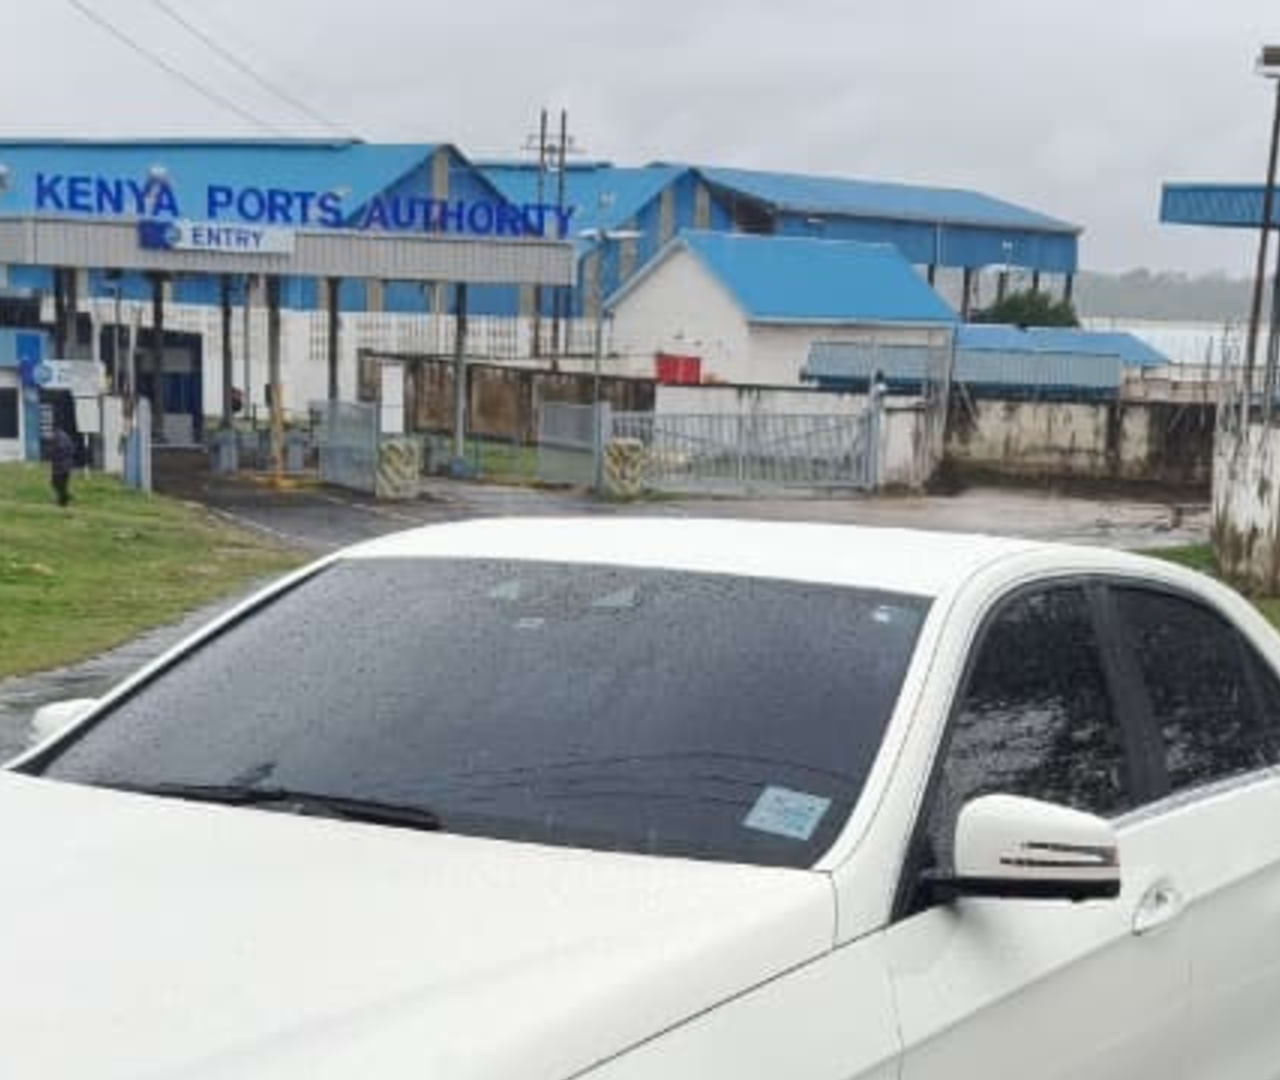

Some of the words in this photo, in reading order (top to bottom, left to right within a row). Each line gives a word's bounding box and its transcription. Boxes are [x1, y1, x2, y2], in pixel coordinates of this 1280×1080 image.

[34, 172, 179, 217] KENYA
[207, 184, 342, 228] PORTS
[358, 196, 574, 240] AUTHORITY
[191, 226, 264, 249] ENTRY
